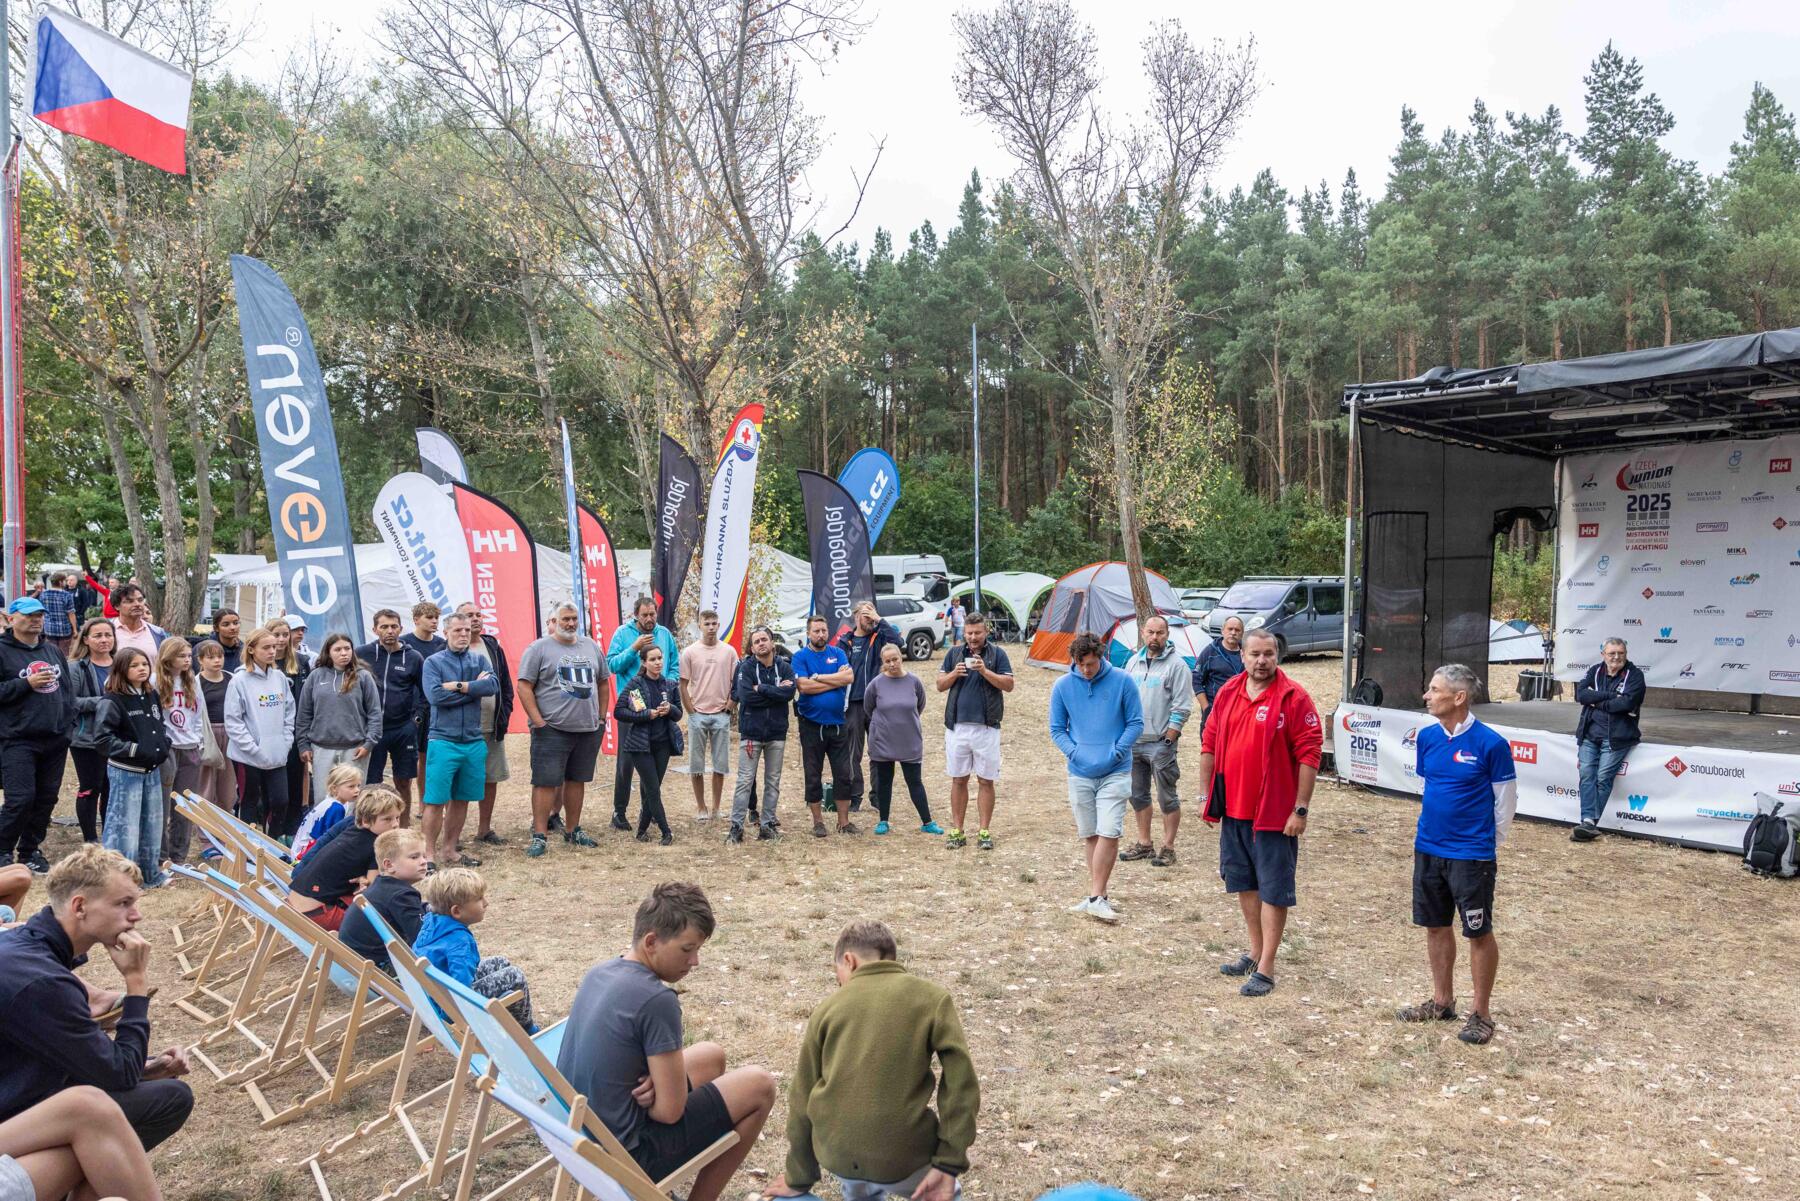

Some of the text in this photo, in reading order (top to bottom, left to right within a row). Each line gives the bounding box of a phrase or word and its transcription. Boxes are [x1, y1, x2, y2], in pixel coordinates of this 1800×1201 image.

[722, 458, 735, 511] SLUŽBA
[871, 485, 896, 530] EQUIPMENT
[1627, 493, 1672, 512] 2025
[1726, 547, 1747, 555] MIKA
[1350, 735, 1377, 752] 2025
[1513, 745, 1533, 759] HH
[1690, 764, 1746, 778] snowboardel
[1616, 811, 1657, 823] WINDESIGN
[1696, 807, 1755, 819] oneyacht.cz
